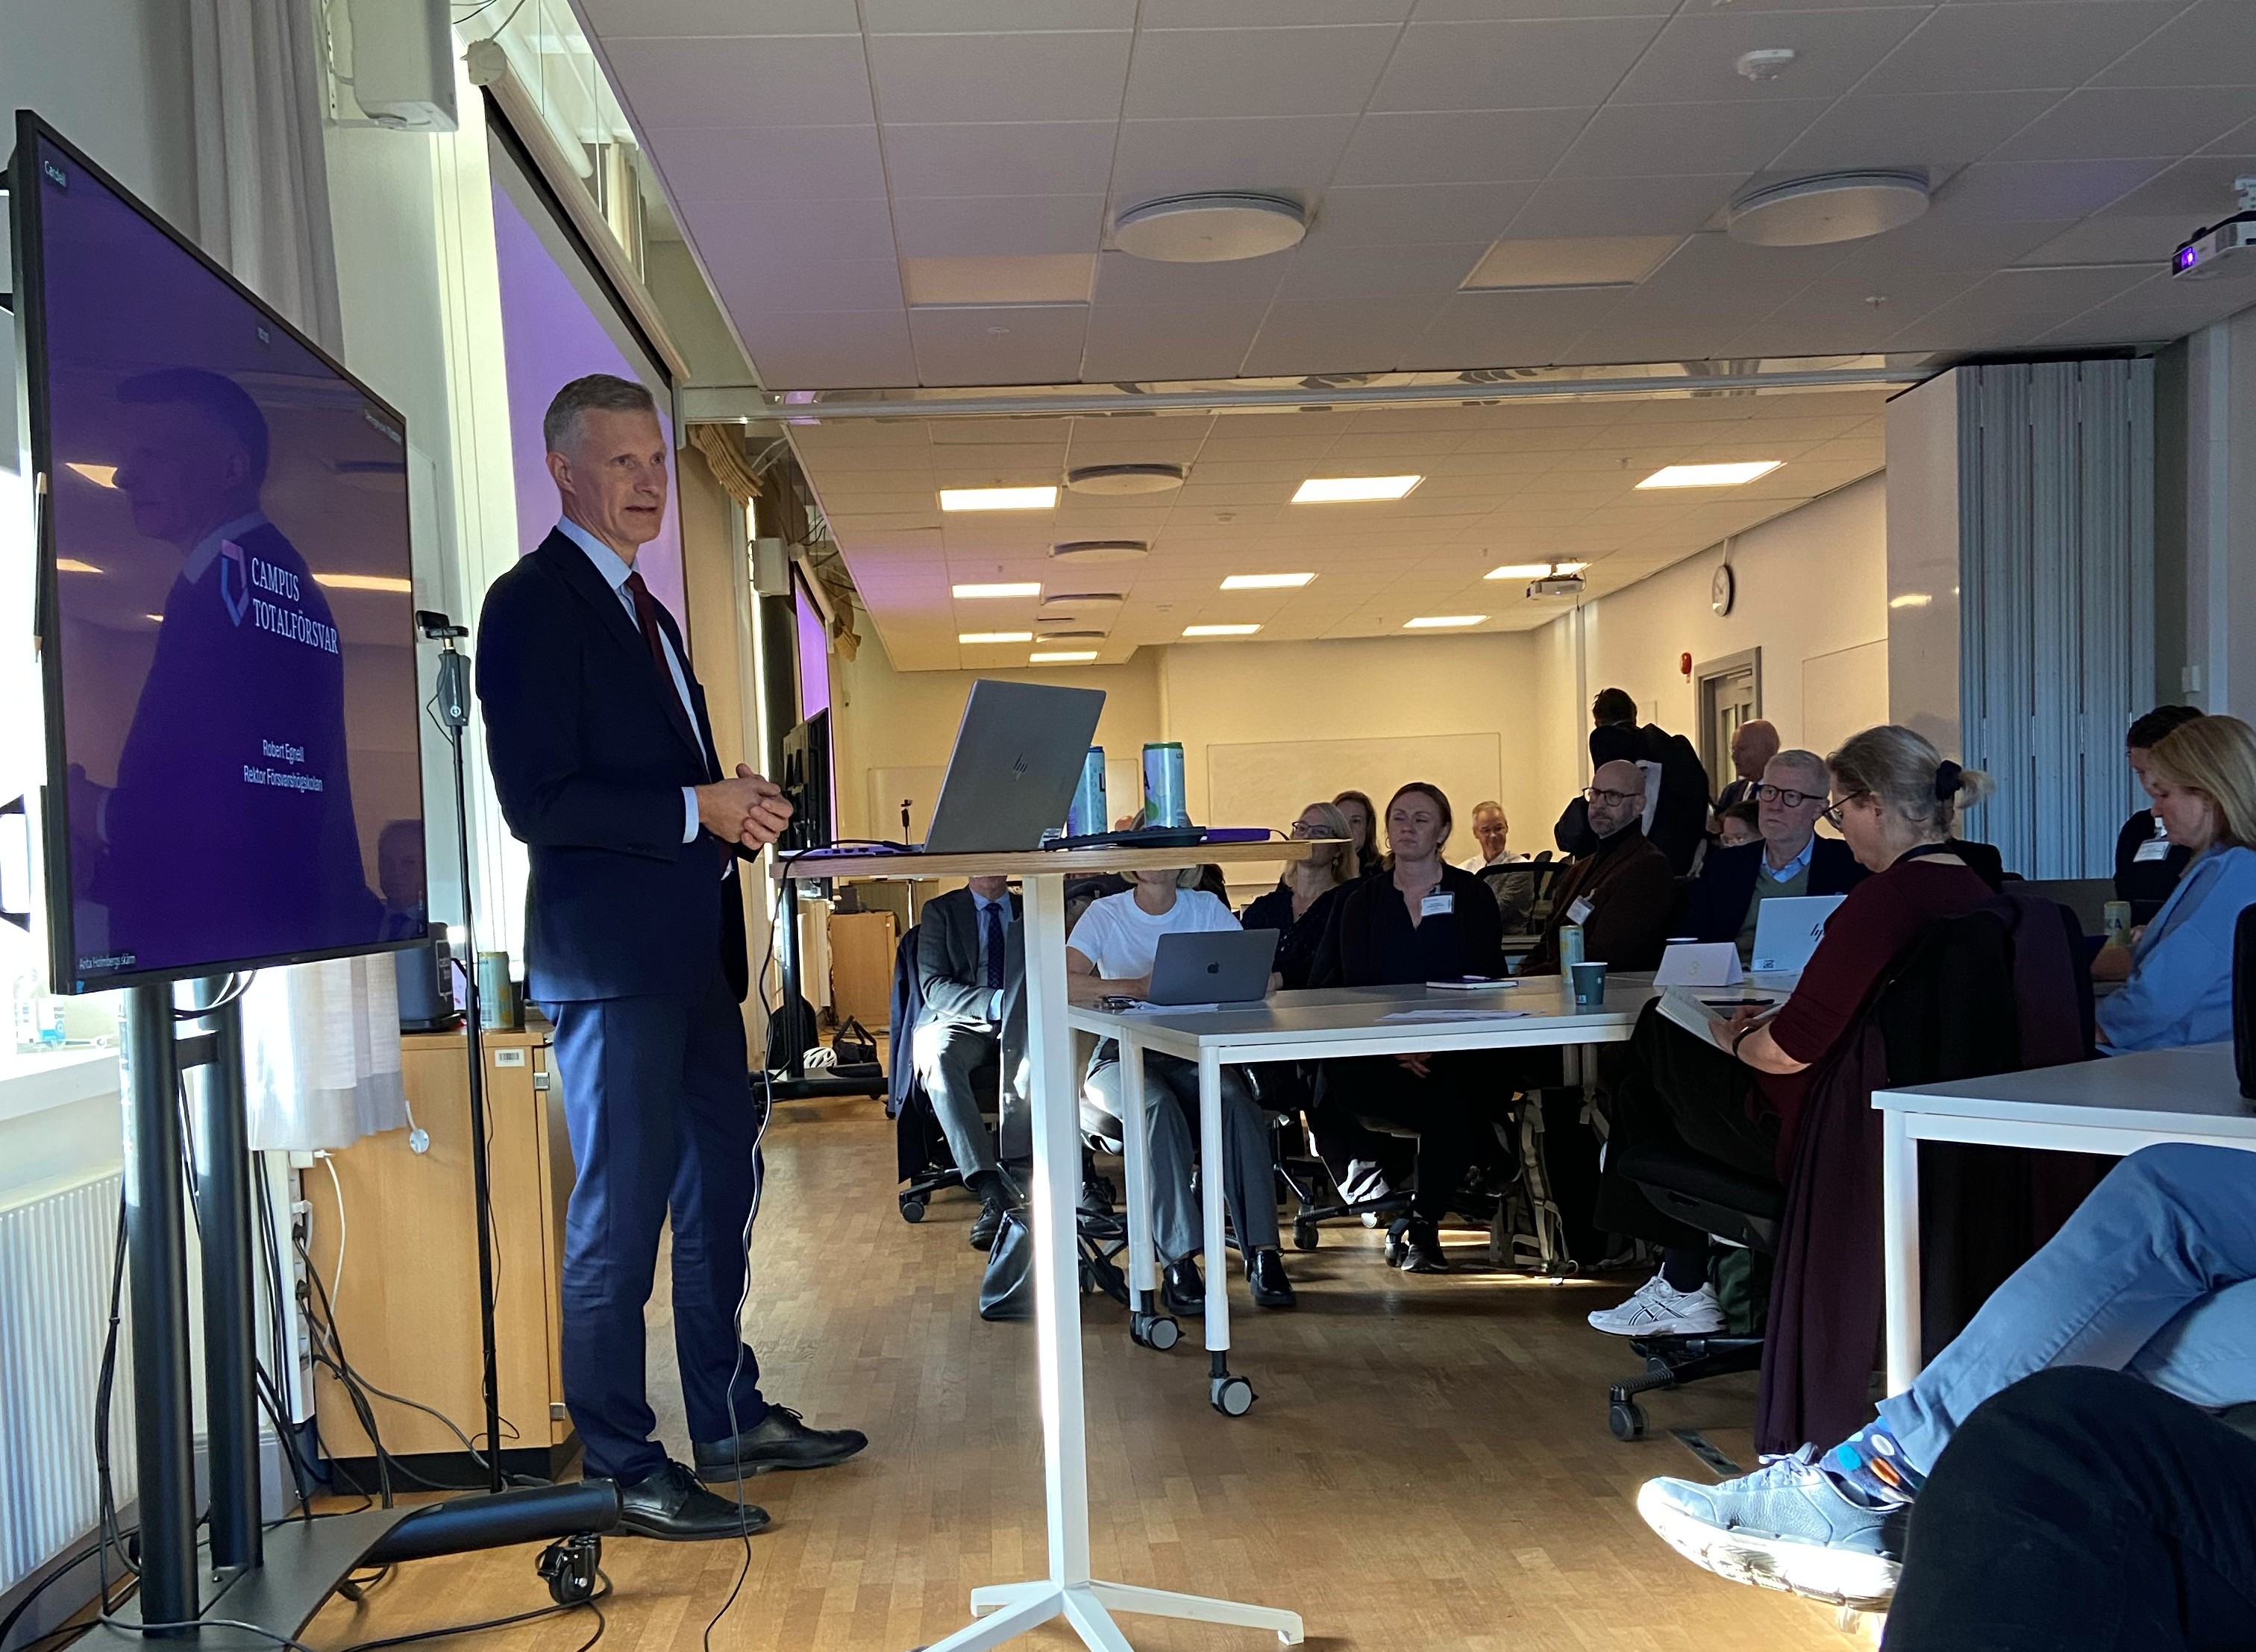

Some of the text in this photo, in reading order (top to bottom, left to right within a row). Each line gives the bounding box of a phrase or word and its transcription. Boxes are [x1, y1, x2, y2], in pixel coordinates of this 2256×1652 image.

[251, 557, 300, 602] CAMPUS
[252, 597, 339, 654] TOTALFÖRSVAR
[263, 739, 304, 764] Robert Egnell
[244, 764, 323, 793] Rektor Försvarshögskolan
